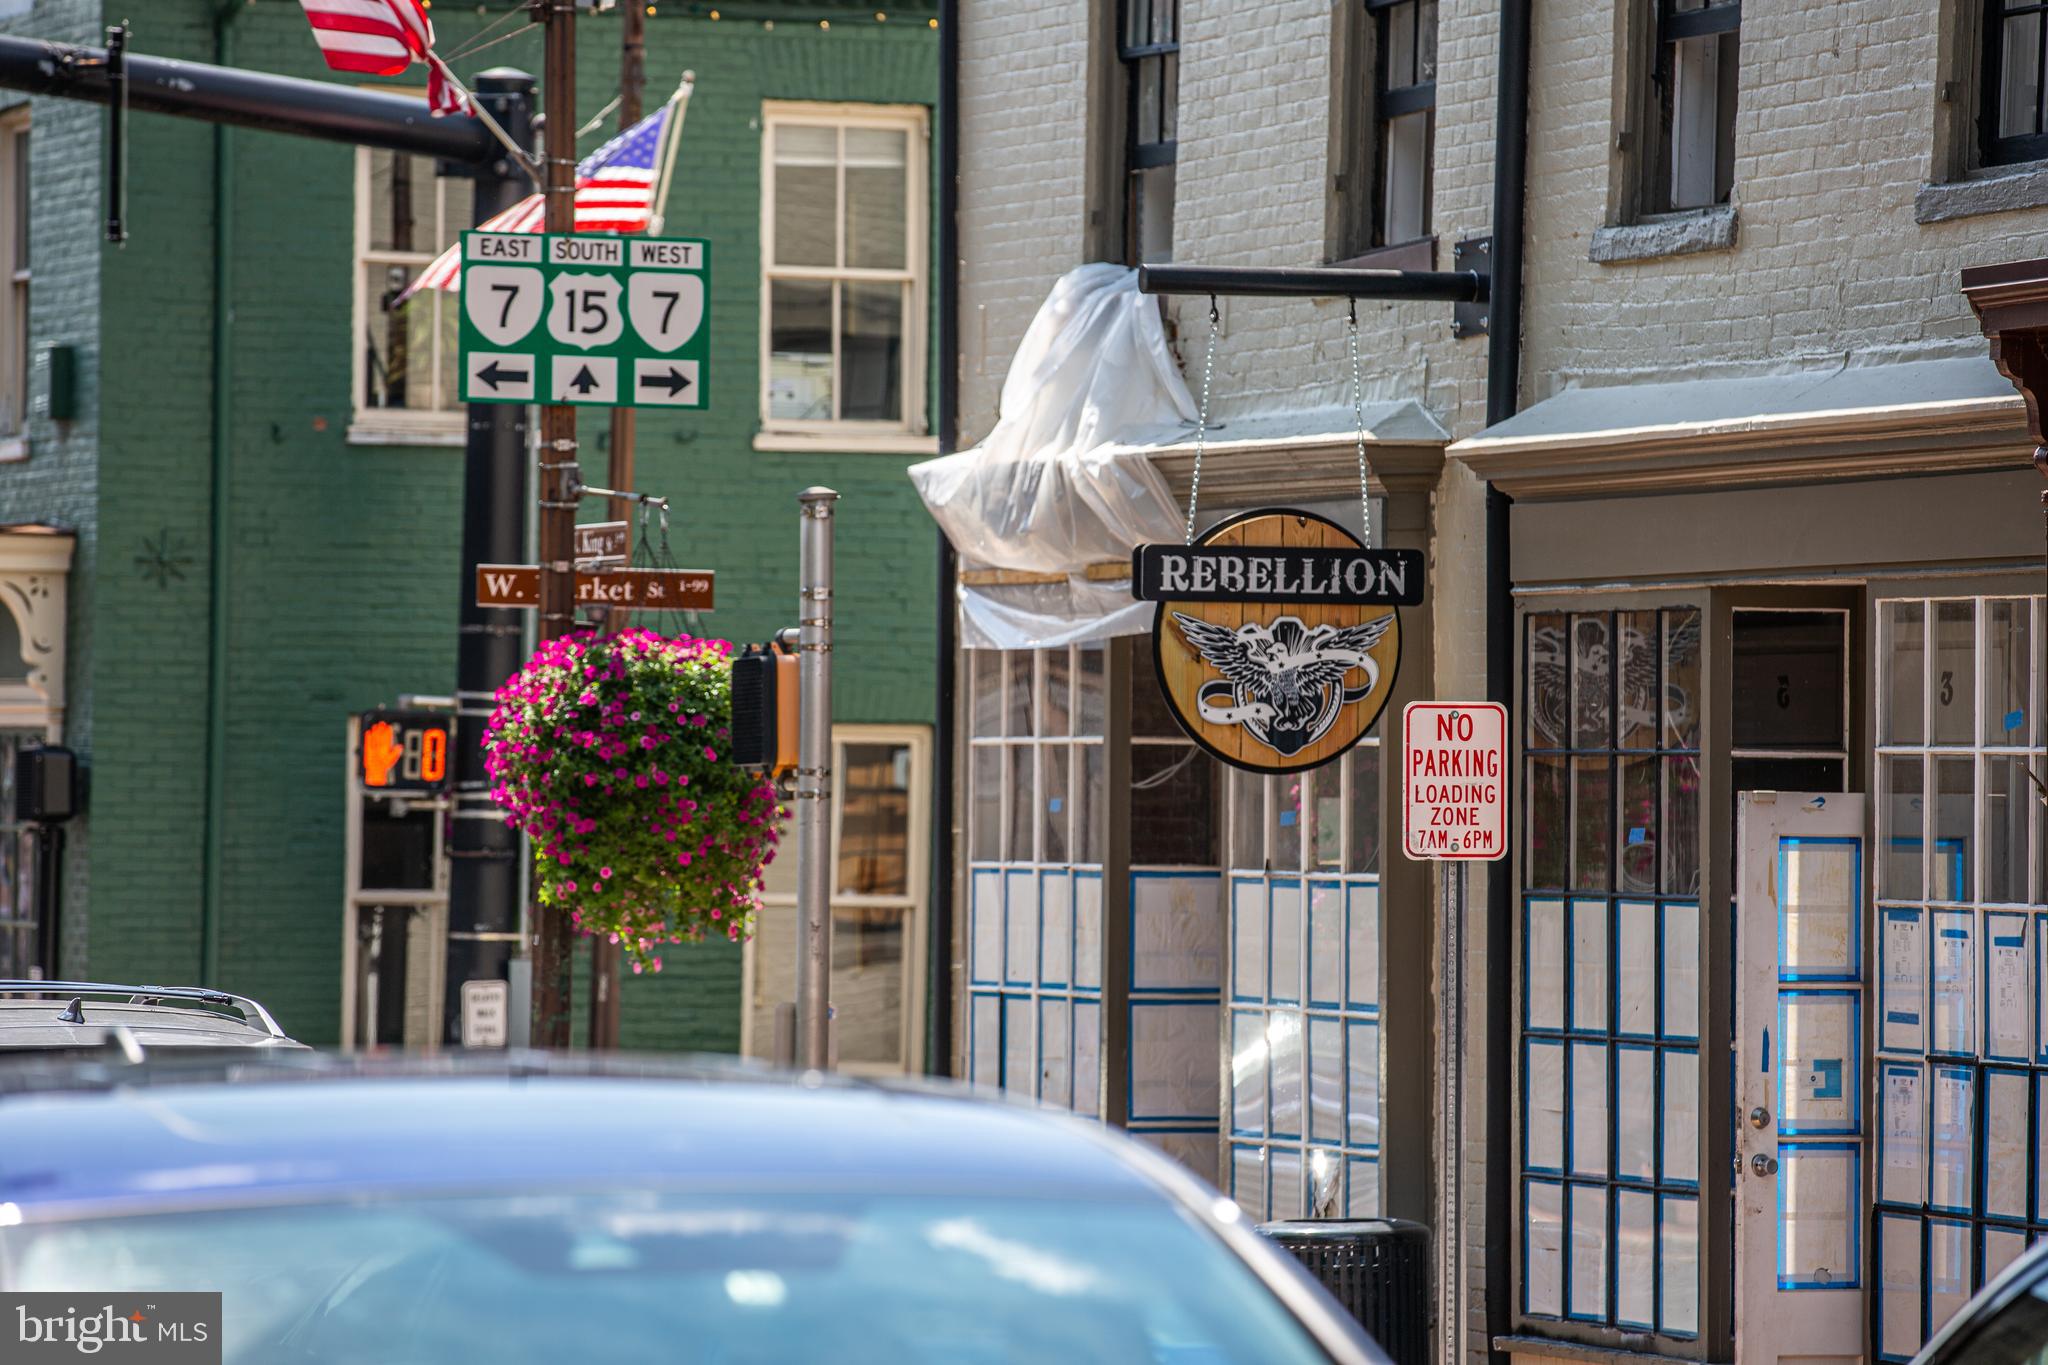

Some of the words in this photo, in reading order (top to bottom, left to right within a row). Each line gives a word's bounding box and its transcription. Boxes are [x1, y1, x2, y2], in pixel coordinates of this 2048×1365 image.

[480, 238, 531, 258] EAST
[556, 241, 618, 261] SOUTH
[641, 245, 692, 264] WEST
[491, 284, 520, 328] 7
[565, 289, 608, 334] 15
[652, 291, 680, 334] 7
[484, 573, 524, 598] W.
[534, 576, 634, 600] rket
[646, 581, 665, 599] St
[1159, 554, 1408, 596] REBELLION
[1940, 671, 1953, 706] 3
[1437, 714, 1474, 741] NO
[1413, 749, 1498, 777] PARKING
[1415, 784, 1496, 804] LOADING
[1431, 807, 1480, 825] ZONE
